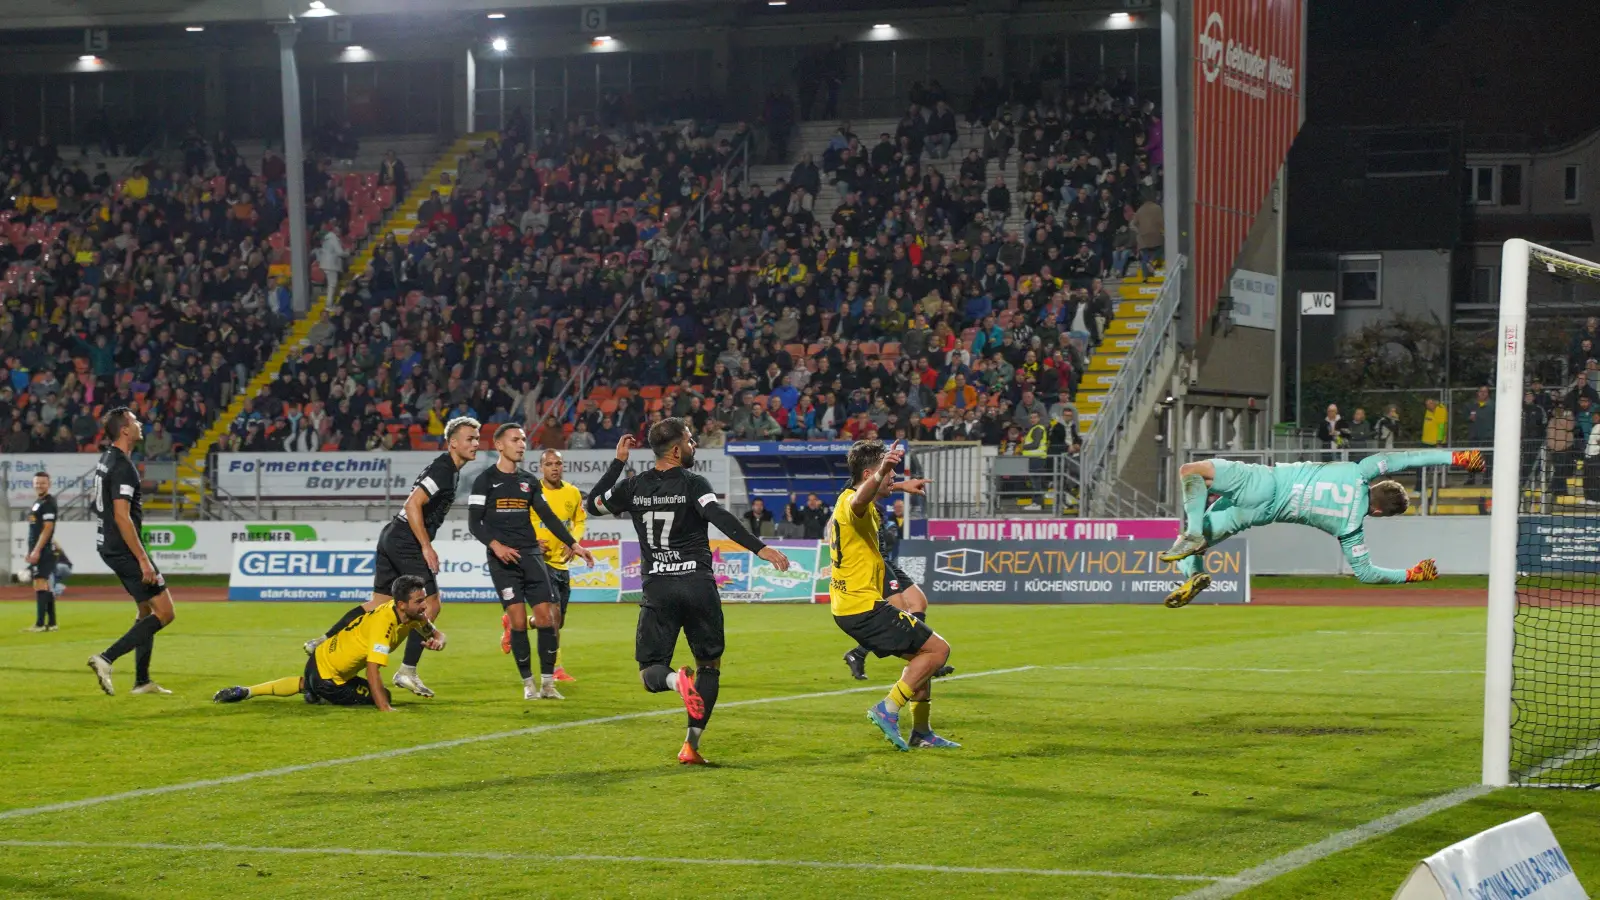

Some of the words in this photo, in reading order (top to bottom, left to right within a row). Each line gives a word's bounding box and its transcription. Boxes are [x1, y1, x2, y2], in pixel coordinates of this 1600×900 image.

[1312, 293, 1332, 308] WC
[653, 494, 686, 505] Hankofen
[143, 531, 171, 543] CHER
[642, 511, 675, 550] 17
[243, 553, 374, 574] GERLITZ
[649, 560, 697, 574] Sturm
[984, 551, 1079, 573] KREATIV
[1087, 551, 1147, 573] HOLZ
[932, 580, 1006, 592] SCHREINEREI
[1024, 578, 1113, 592] KÜCHENSTUDIO
[260, 588, 328, 598] starkstrom
[339, 588, 373, 600] anlag
